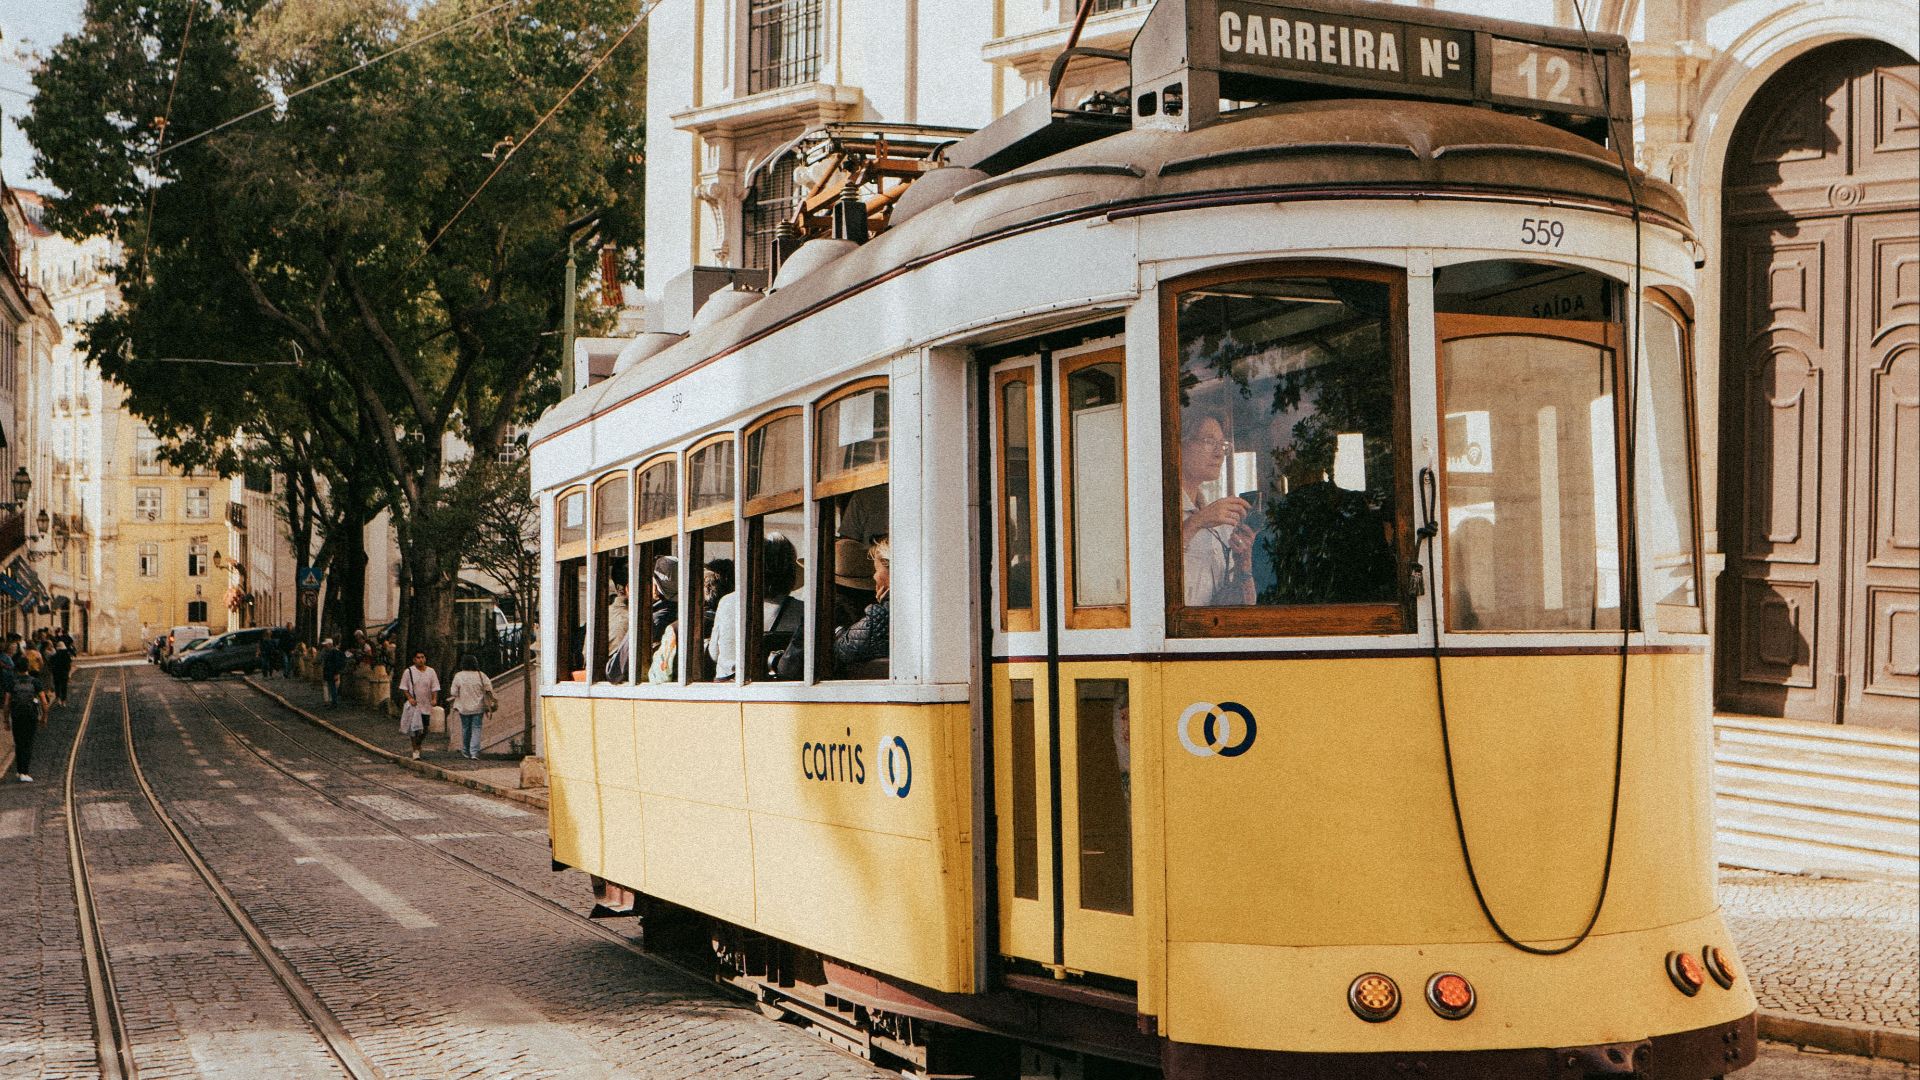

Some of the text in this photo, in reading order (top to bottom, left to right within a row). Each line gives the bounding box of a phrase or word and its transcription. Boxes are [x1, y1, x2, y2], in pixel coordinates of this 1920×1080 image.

[1219, 11, 1400, 72] CARREIRA
[1518, 52, 1571, 104] 12
[1521, 218, 1564, 248] 559
[1532, 294, 1584, 318] SAÍDA
[672, 392, 682, 412] 559
[802, 726, 865, 784] carris
